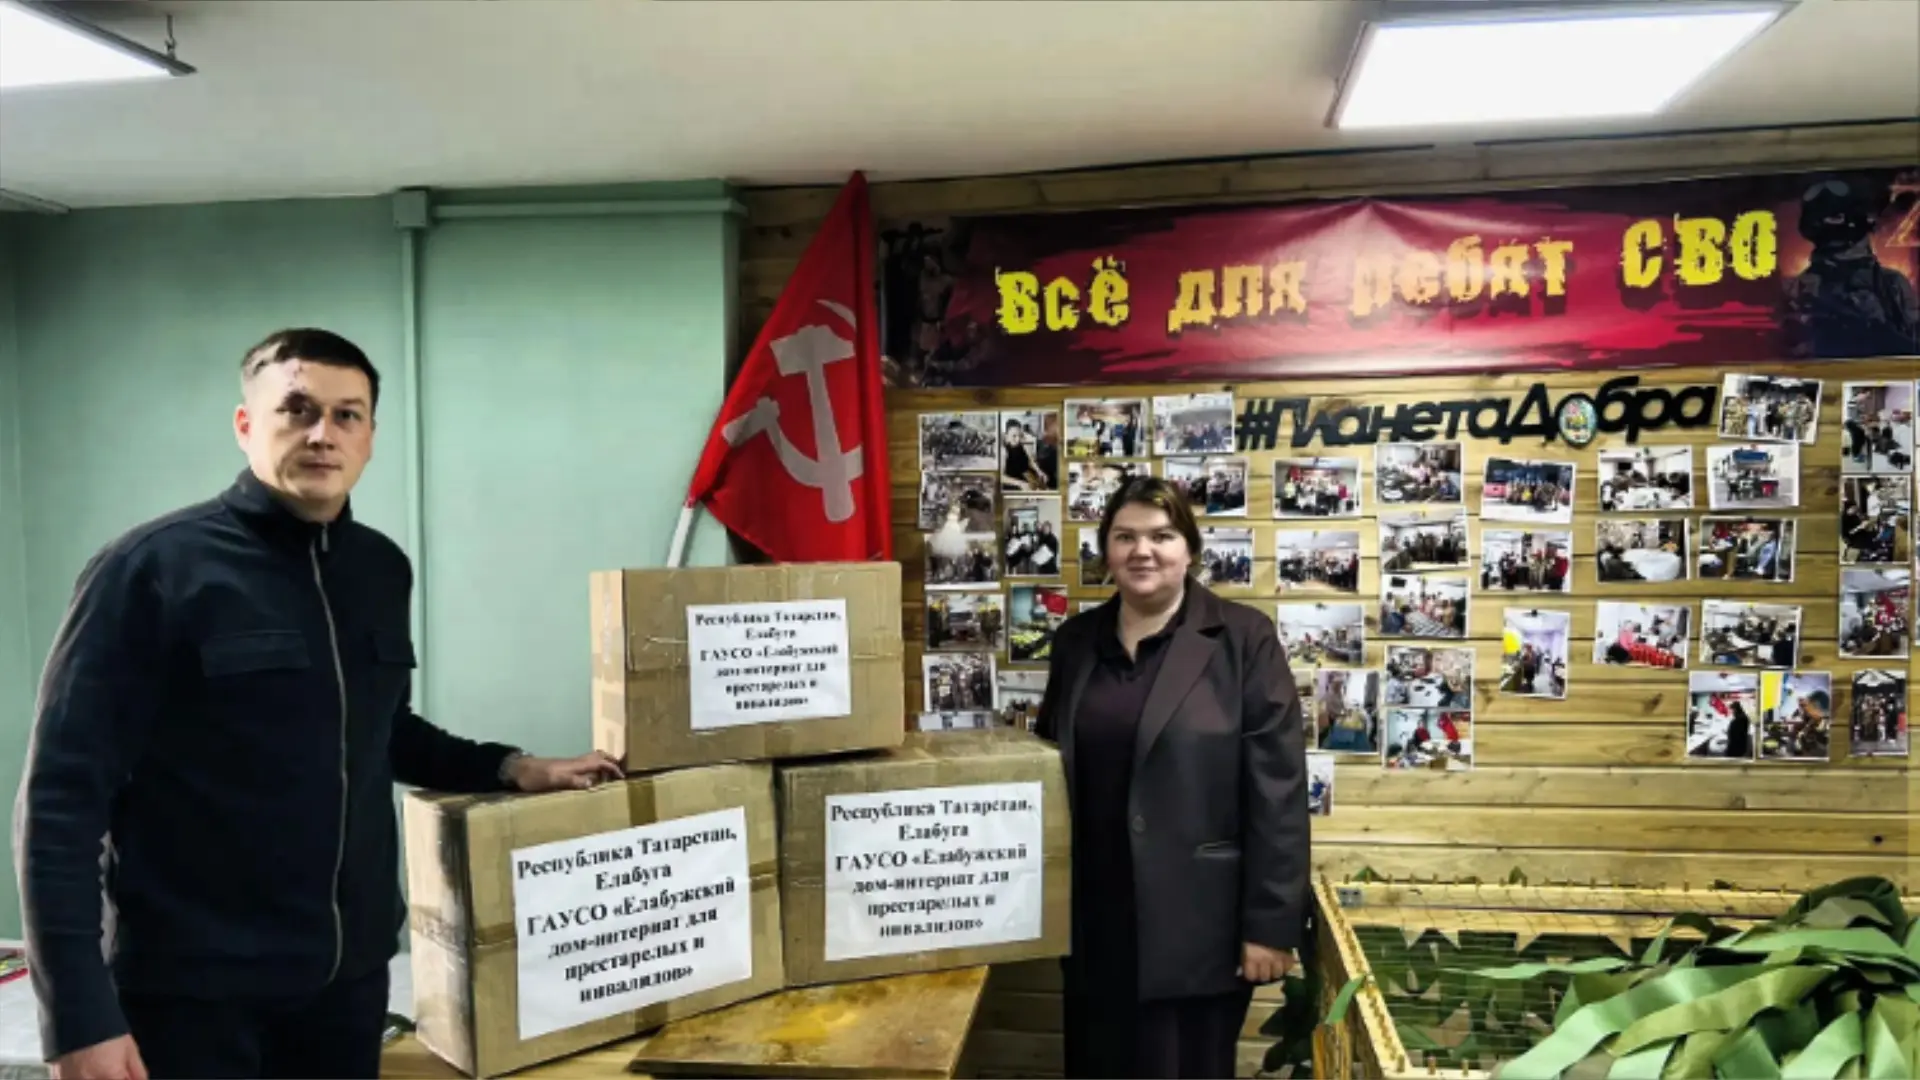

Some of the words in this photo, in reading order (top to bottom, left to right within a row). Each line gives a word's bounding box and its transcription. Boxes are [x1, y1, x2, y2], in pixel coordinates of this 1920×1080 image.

[995, 255, 1129, 335] Всё
[1167, 260, 1307, 333] для
[1621, 209, 1779, 288] СВО
[1234, 376, 1717, 450] #ПланетаДобра
[831, 801, 936, 822] Республика
[940, 798, 1032, 817] Татарстан,
[899, 822, 968, 842] Елабуга
[517, 844, 634, 880] Республика
[637, 825, 737, 858] Татарстан,
[835, 852, 907, 872] ГАУСО
[912, 843, 1028, 866] «Елабужский
[595, 863, 672, 891] Елабуга
[852, 874, 974, 895] дом-интернат
[978, 870, 1009, 886] для
[526, 904, 608, 936] ГАУСО
[613, 877, 736, 917] «Елабужский
[868, 896, 980, 918] престарелых
[984, 894, 996, 906] и
[548, 917, 679, 959] дом-интернат
[685, 908, 718, 933] для
[565, 940, 688, 981] престарелых
[693, 935, 705, 950] и
